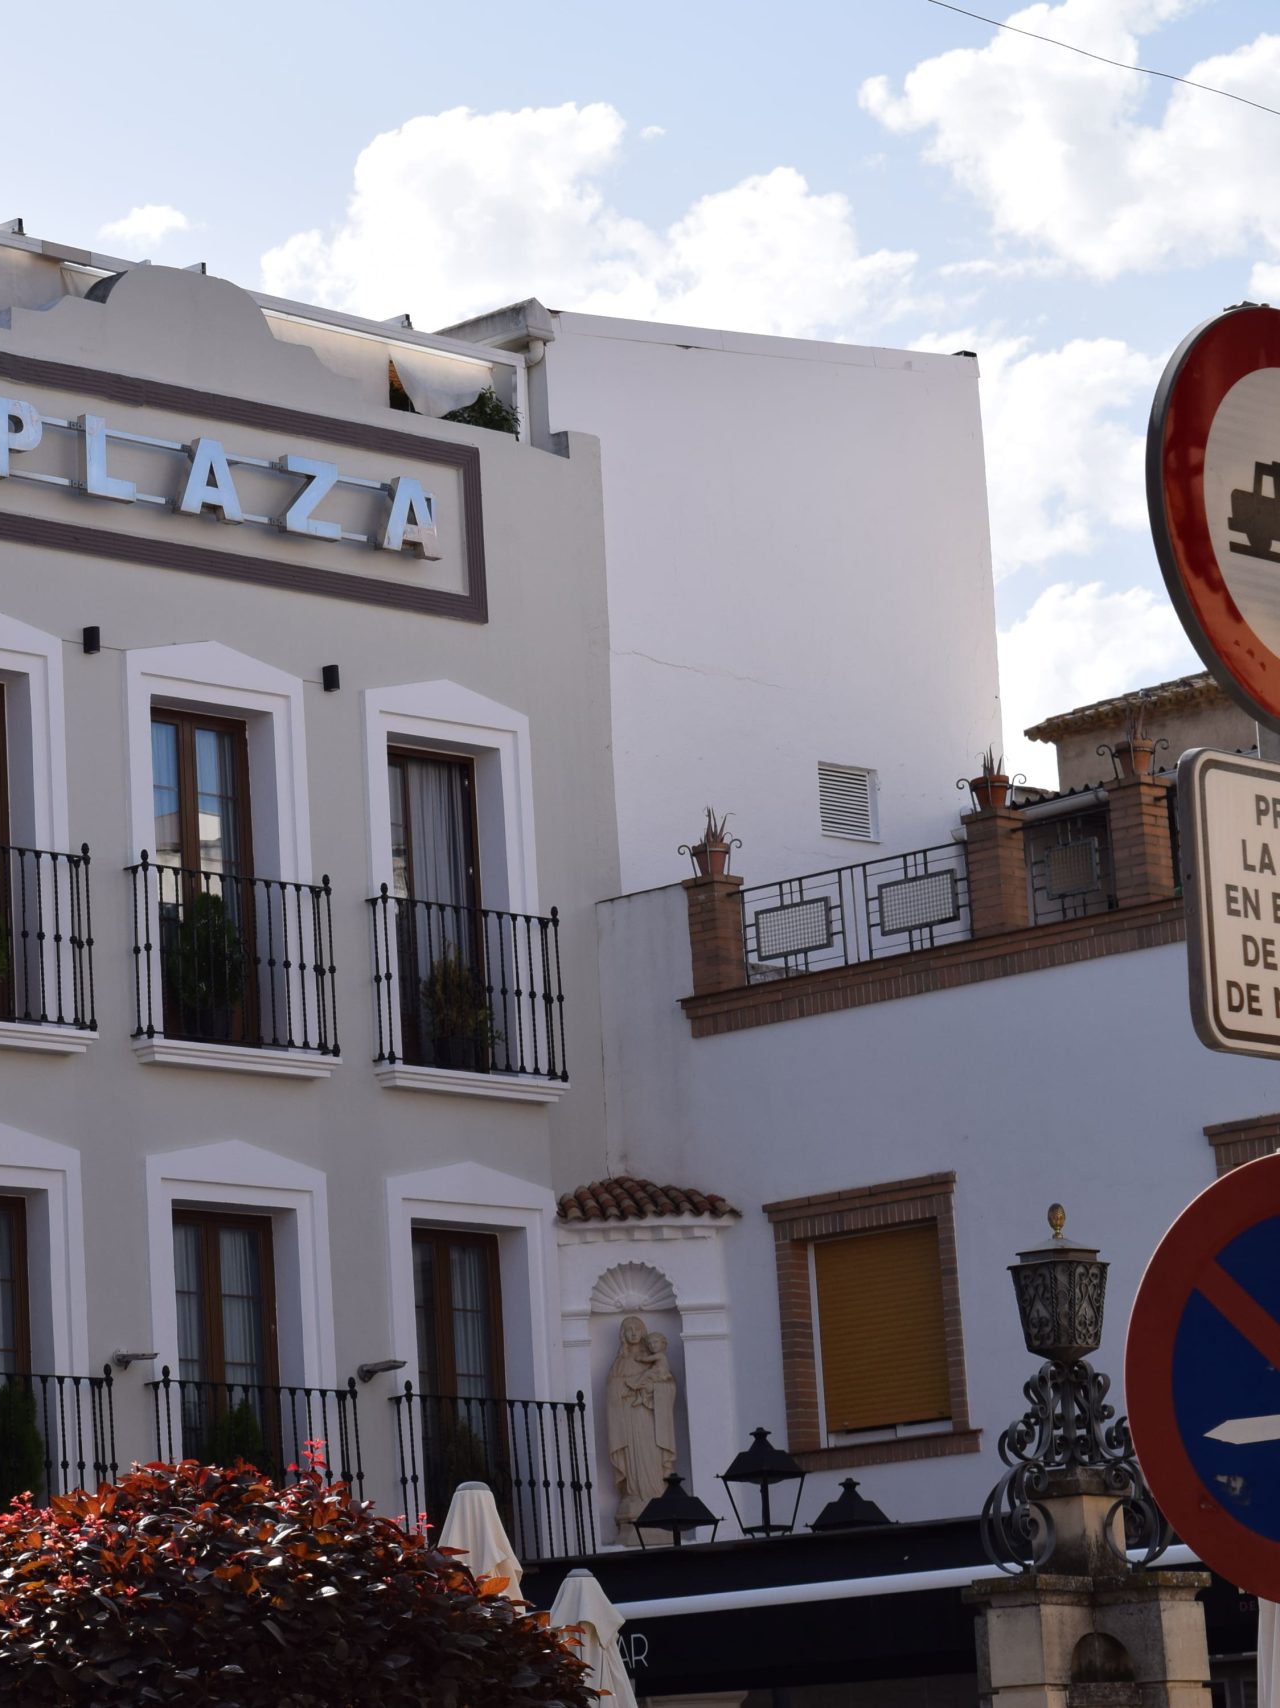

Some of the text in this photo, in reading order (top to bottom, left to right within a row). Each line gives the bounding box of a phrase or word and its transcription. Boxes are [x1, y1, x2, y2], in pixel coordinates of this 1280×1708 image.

[1241, 839, 1276, 876] LA
[1225, 883, 1261, 921] EN
[1241, 934, 1278, 971] DE
[1226, 980, 1263, 1016] DE
